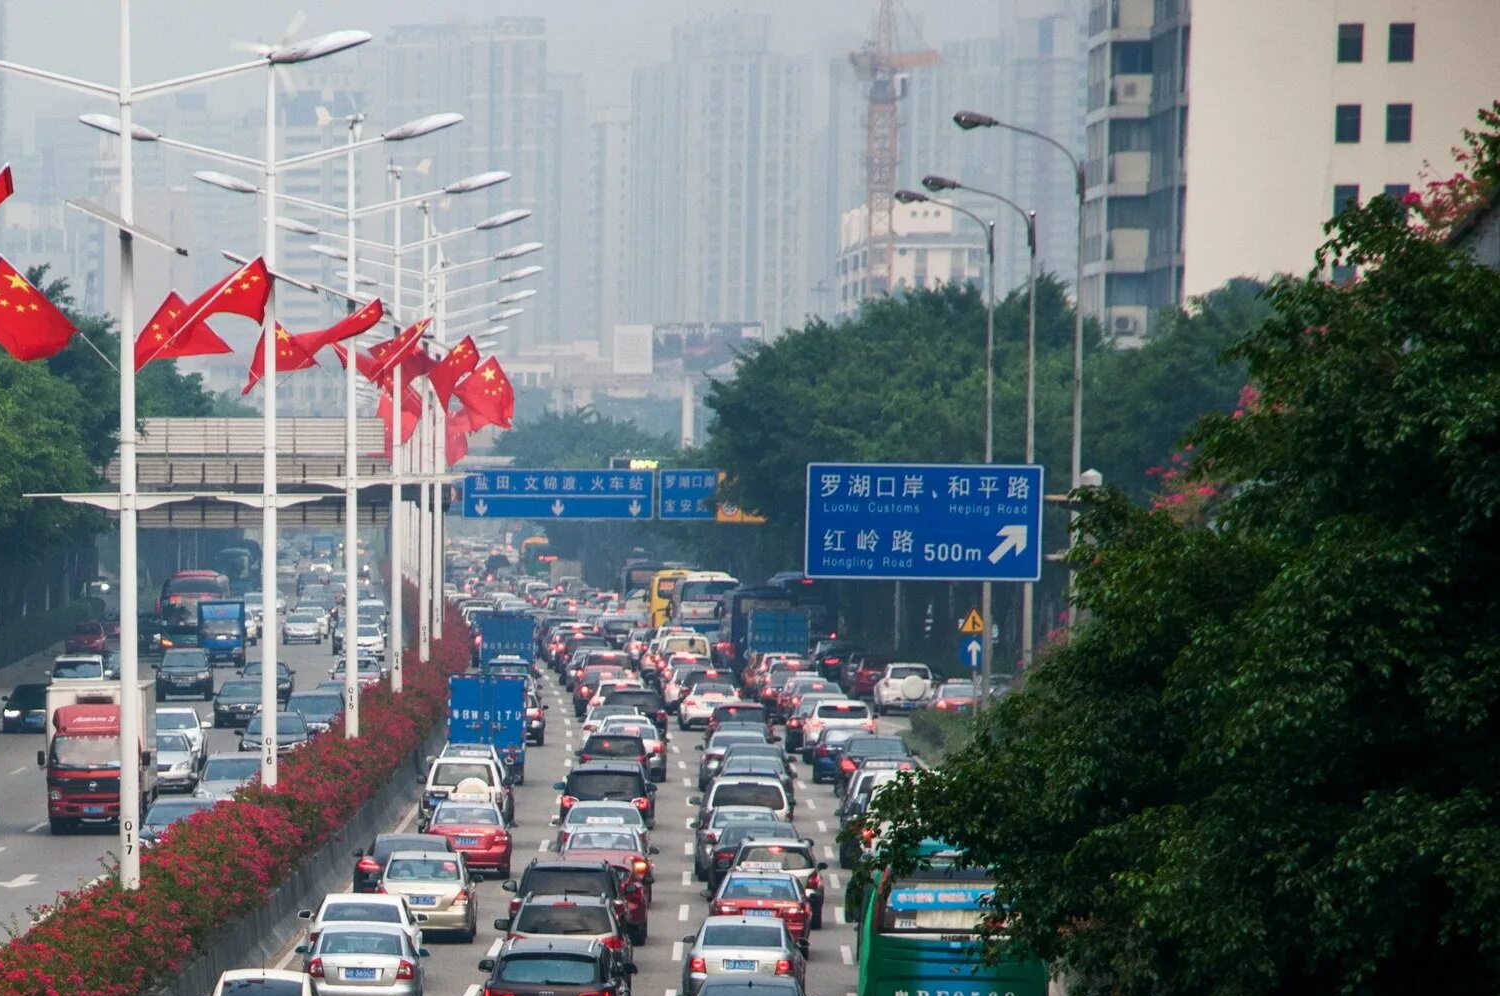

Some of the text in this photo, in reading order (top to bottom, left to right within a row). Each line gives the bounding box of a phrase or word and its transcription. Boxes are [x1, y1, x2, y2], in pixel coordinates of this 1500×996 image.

[824, 503, 920, 513] Luohu Customs
[949, 504, 1029, 516] Heping Road
[823, 529, 914, 553] 红岭路
[924, 544, 981, 561] 500m
[822, 557, 913, 569] Hongling Road
[265, 737, 273, 765] 016
[124, 821, 133, 855] 017
